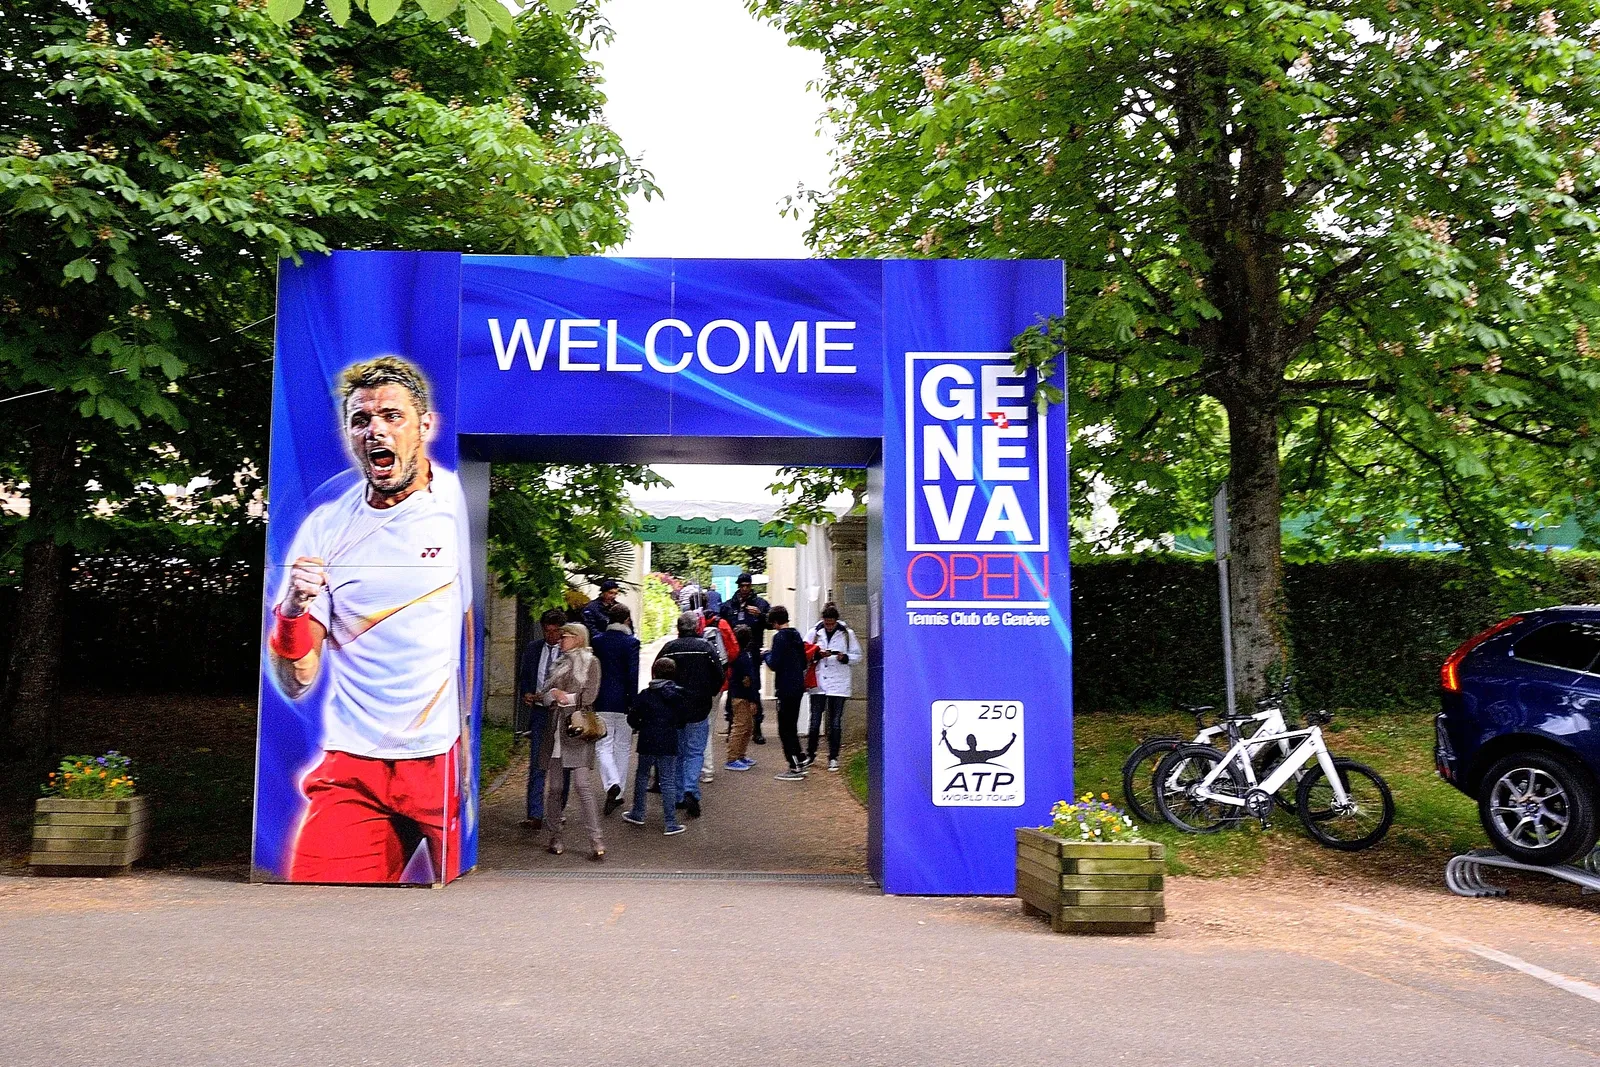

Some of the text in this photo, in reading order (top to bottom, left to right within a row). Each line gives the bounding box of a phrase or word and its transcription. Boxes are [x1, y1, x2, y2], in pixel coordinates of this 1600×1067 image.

[487, 318, 857, 374] WELCOME
[723, 526, 744, 537] Info
[906, 552, 1049, 600] OPEN
[906, 611, 1051, 626] Tennis Club de Genève
[978, 705, 1018, 720] 250
[943, 772, 1015, 792] ATP
[941, 794, 1016, 802] WORLD TOUR
